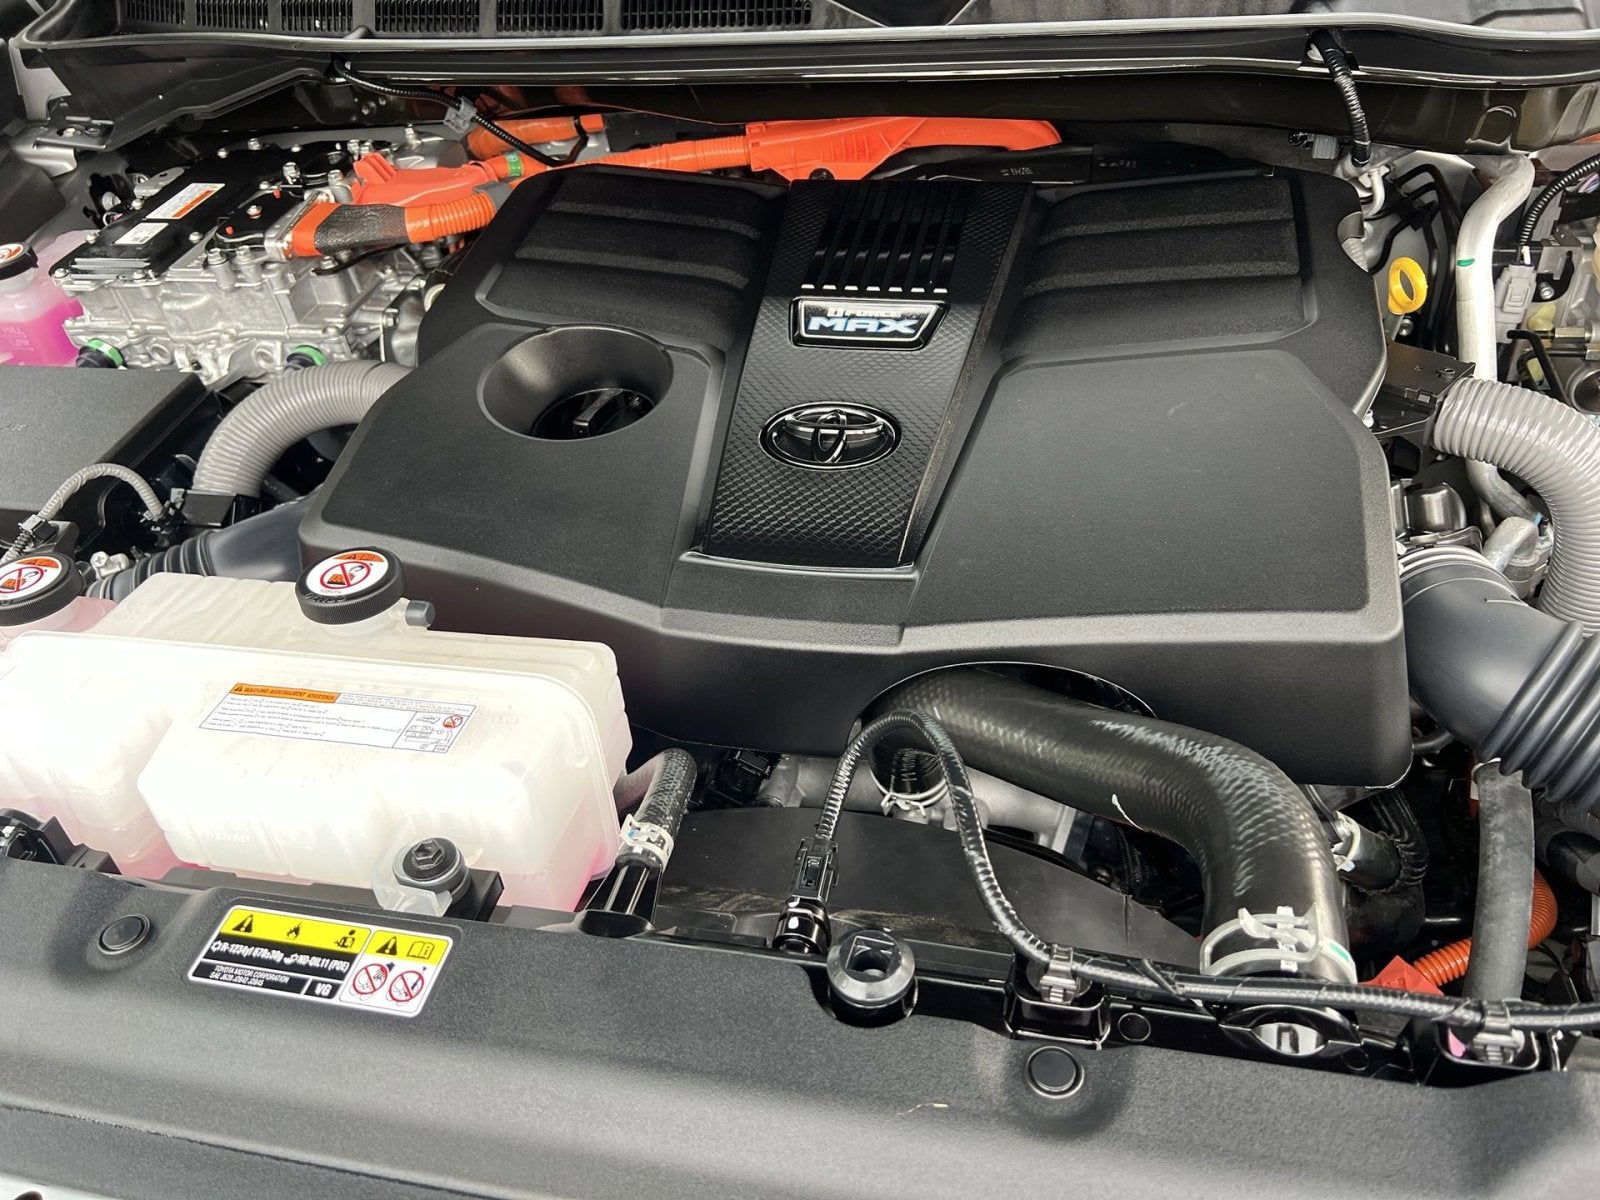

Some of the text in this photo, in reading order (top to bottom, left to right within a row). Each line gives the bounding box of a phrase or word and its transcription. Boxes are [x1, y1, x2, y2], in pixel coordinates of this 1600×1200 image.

[807, 316, 919, 334] MAX
[215, 964, 291, 984] TOYOTA MOTOR CORPORATION
[314, 982, 333, 997] VG
